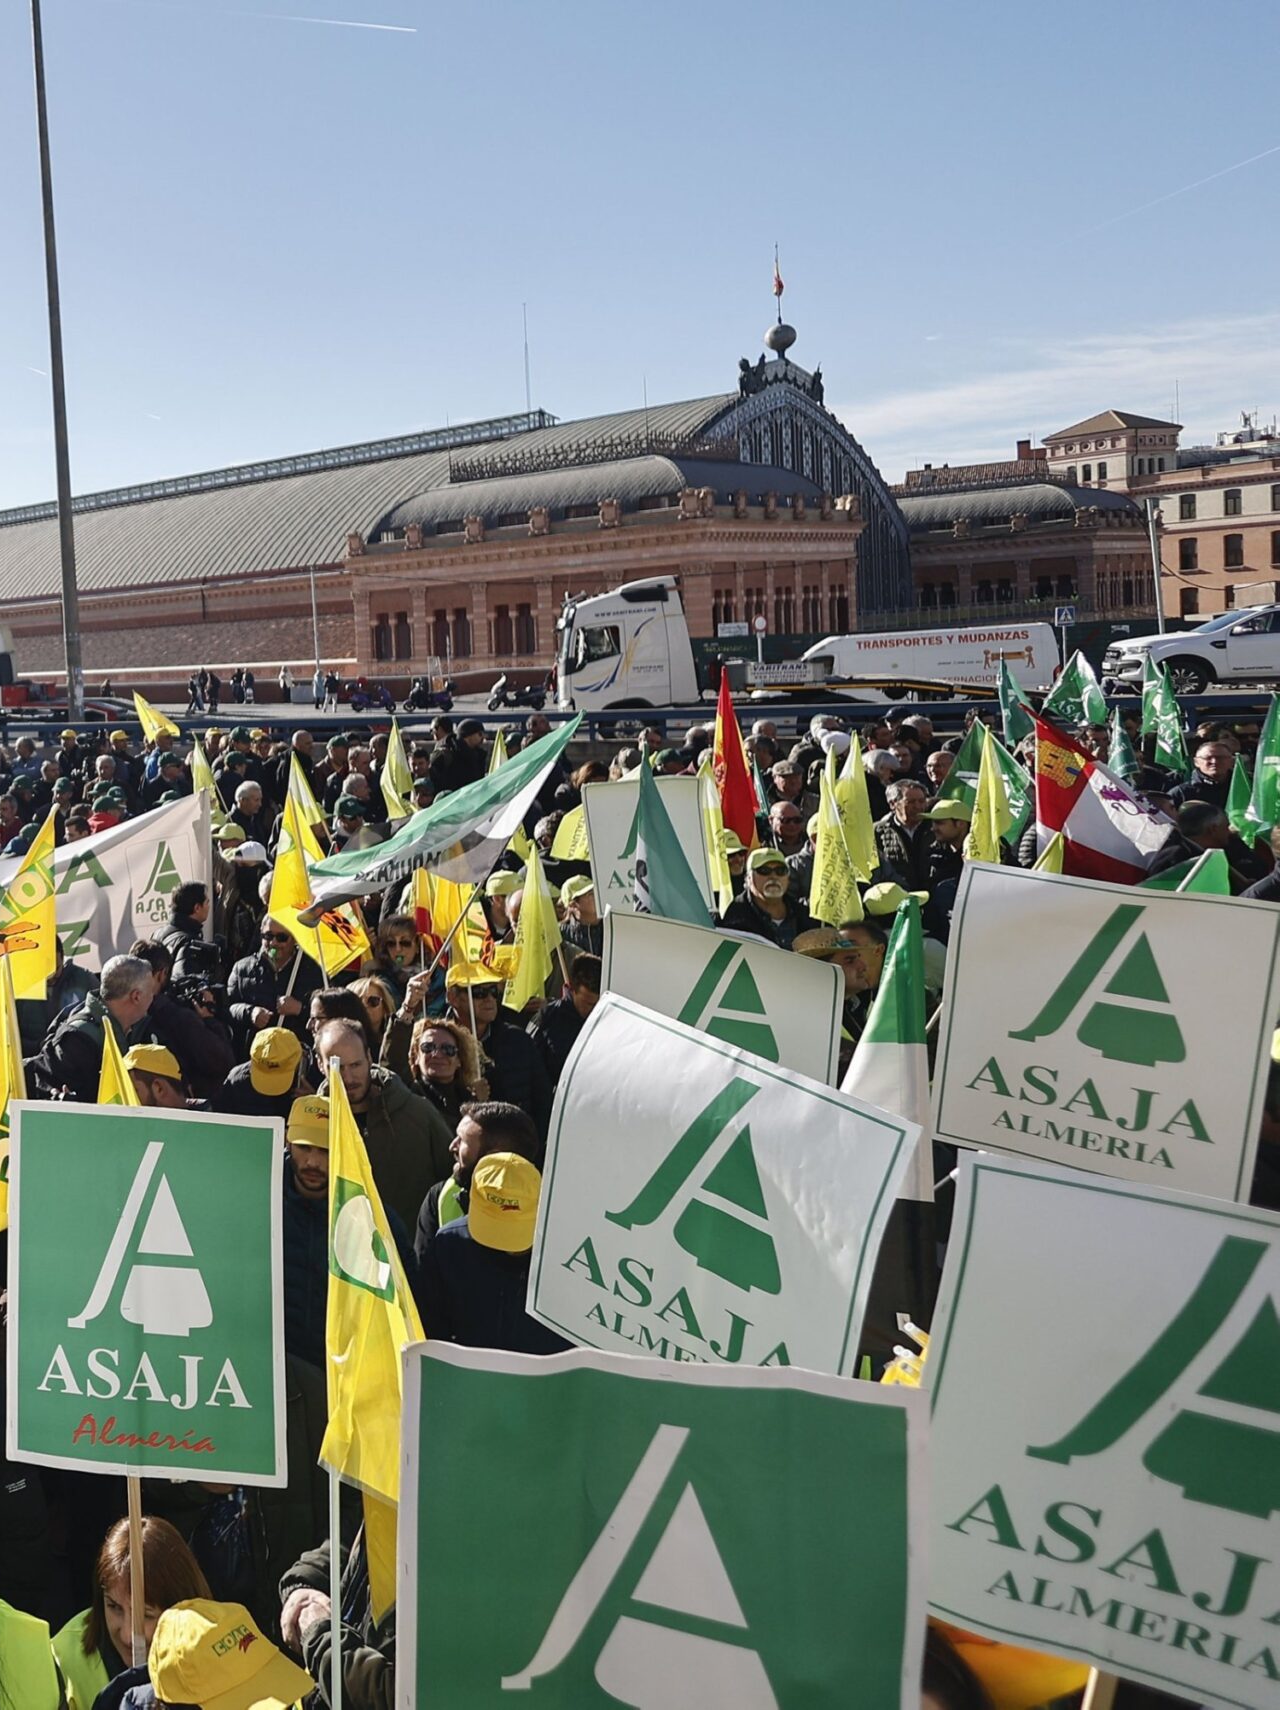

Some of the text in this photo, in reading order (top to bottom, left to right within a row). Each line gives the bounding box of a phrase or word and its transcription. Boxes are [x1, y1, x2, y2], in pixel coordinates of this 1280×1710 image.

[856, 630, 1030, 650] TRANSPORTES Y MUDANZAS
[965, 1055, 1216, 1145] ASAJA
[992, 1109, 1177, 1170] ALMERIA
[585, 1302, 709, 1363] ALME
[36, 1343, 253, 1411] ASAJA
[71, 1412, 217, 1454] Almería
[944, 1483, 1280, 1619] ASAJ
